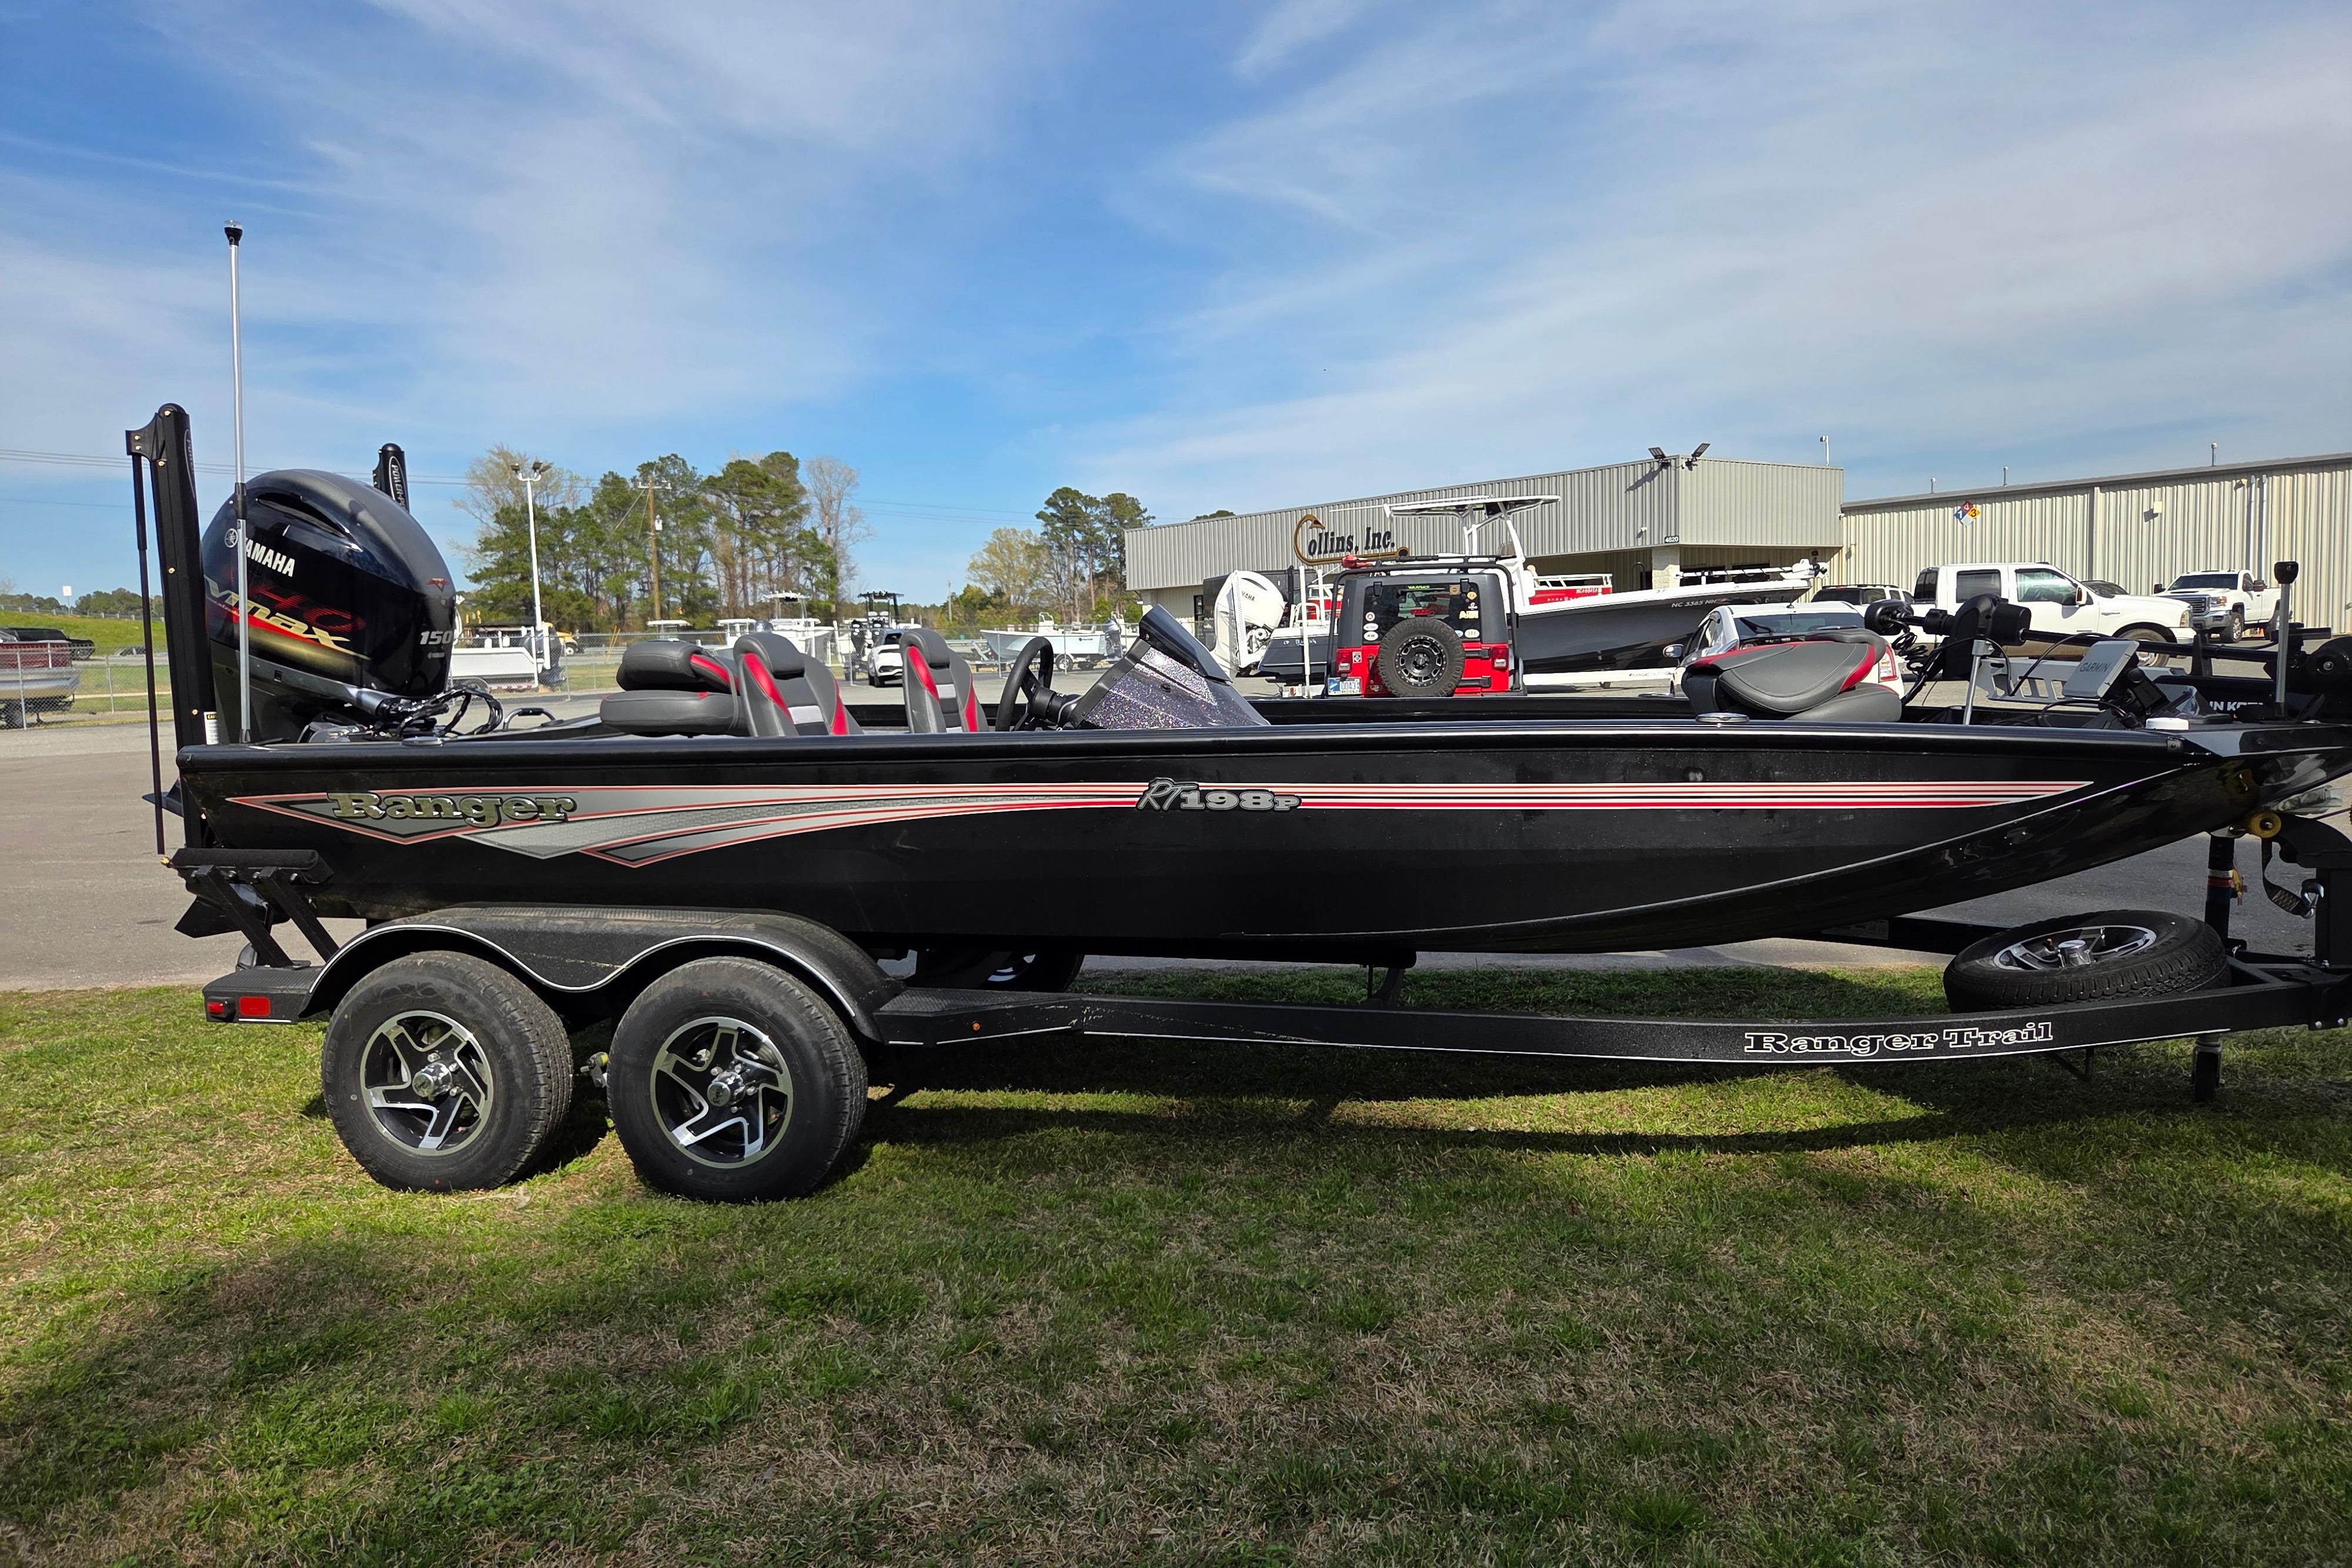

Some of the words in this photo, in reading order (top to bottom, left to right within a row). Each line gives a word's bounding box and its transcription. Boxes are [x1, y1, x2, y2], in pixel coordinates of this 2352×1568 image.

[1957, 510, 1962, 519] 1
[1970, 509, 1977, 517] 3
[1364, 527, 1395, 551] Inc.
[245, 537, 295, 577] AMAHA
[420, 630, 453, 645] 150
[2080, 663, 2110, 673] GARMIN
[327, 791, 579, 828] Ranger
[1744, 1032, 1938, 1057] Ranger
[1943, 1022, 2053, 1048] Trail
